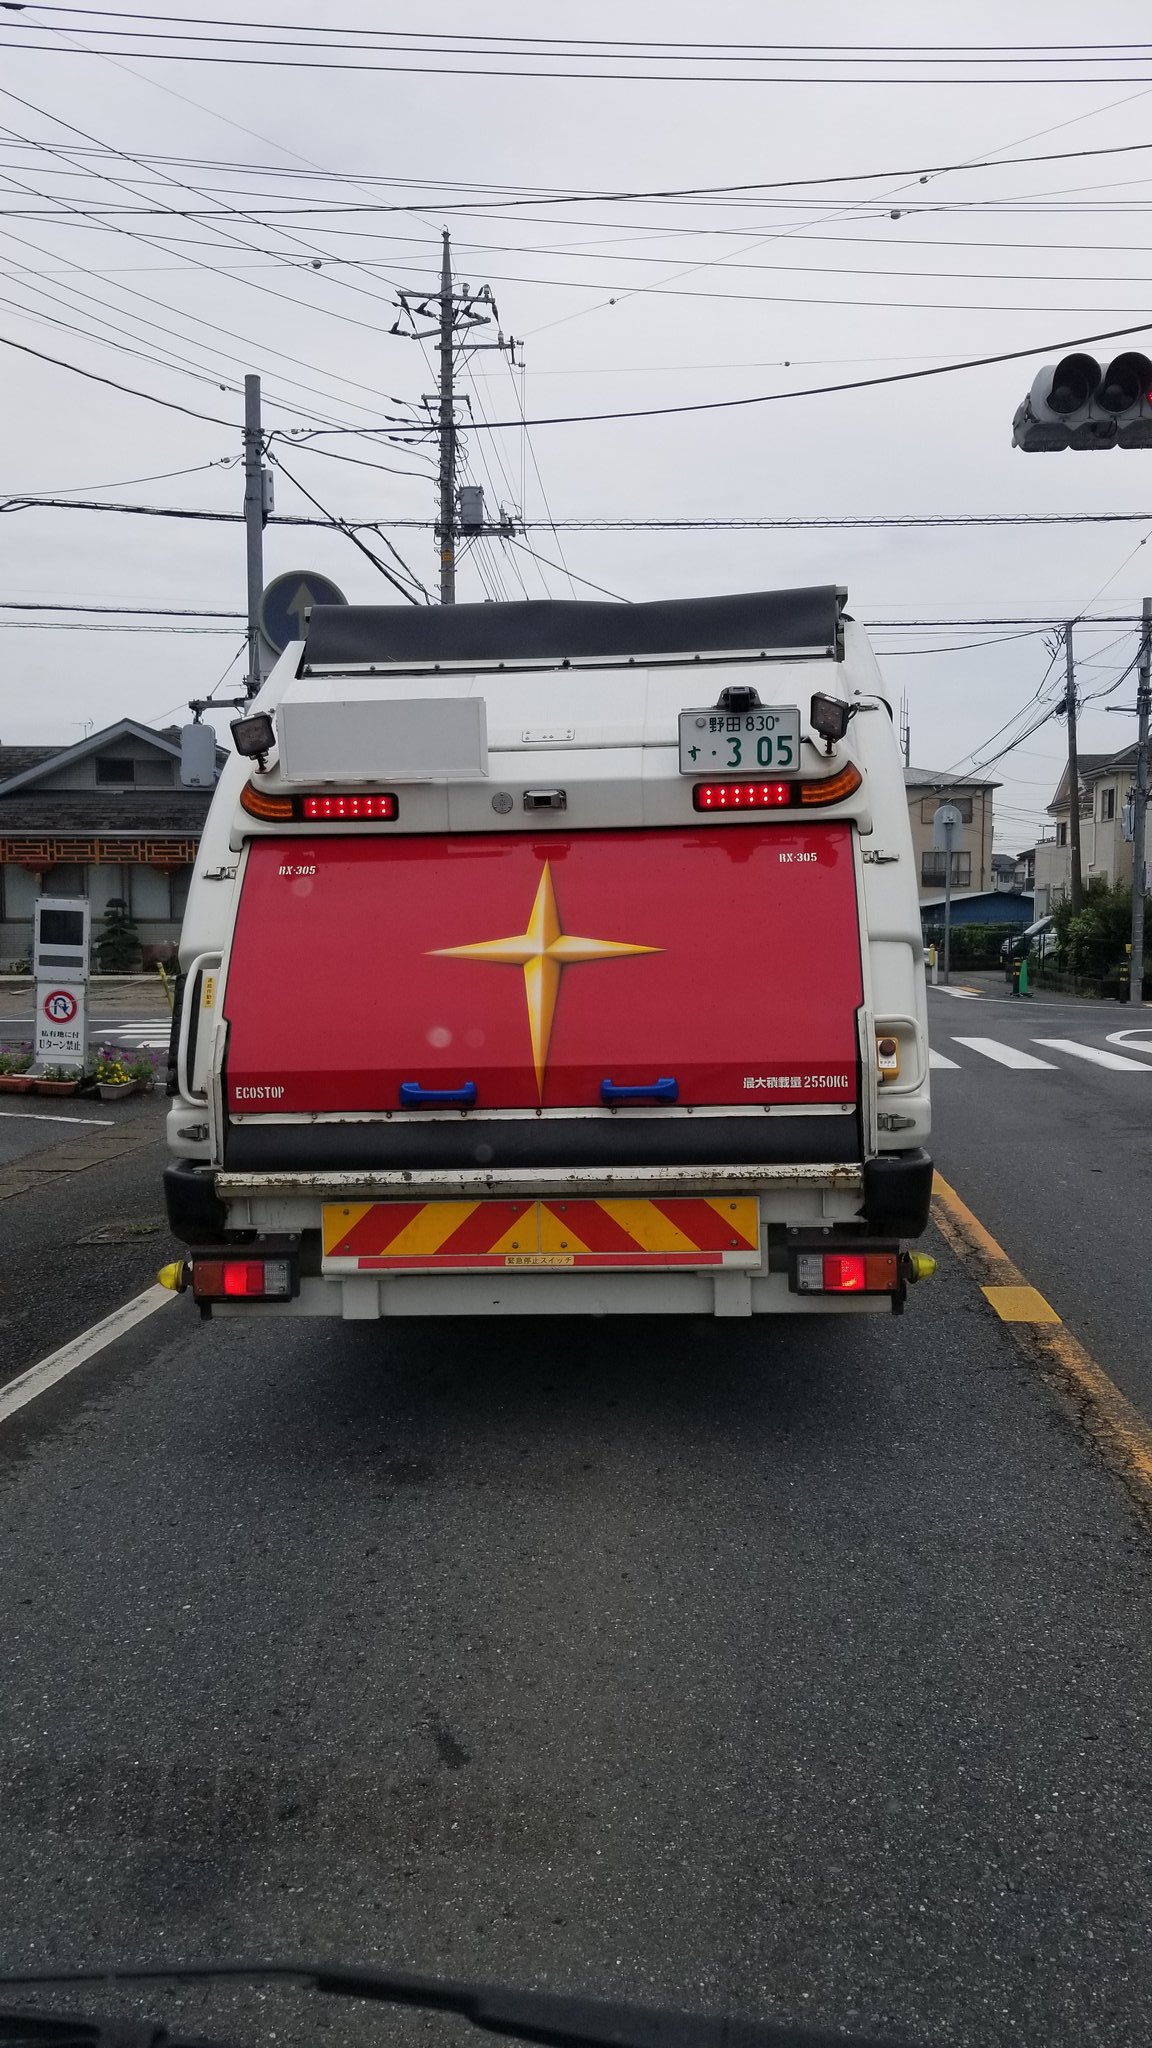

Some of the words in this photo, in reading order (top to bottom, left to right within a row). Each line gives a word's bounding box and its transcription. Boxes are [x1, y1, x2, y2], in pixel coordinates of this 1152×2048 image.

[709, 717, 741, 733] 野田
[745, 715, 775, 731] 830
[687, 745, 702, 762] す
[39, 1039, 81, 1051] Uターン禁止
[743, 1077, 802, 1089] 最大積載量
[803, 1075, 849, 1088] 2550KG
[235, 1086, 285, 1099] ECOSTOP
[507, 1256, 572, 1266] 緊急停止スイッチ
